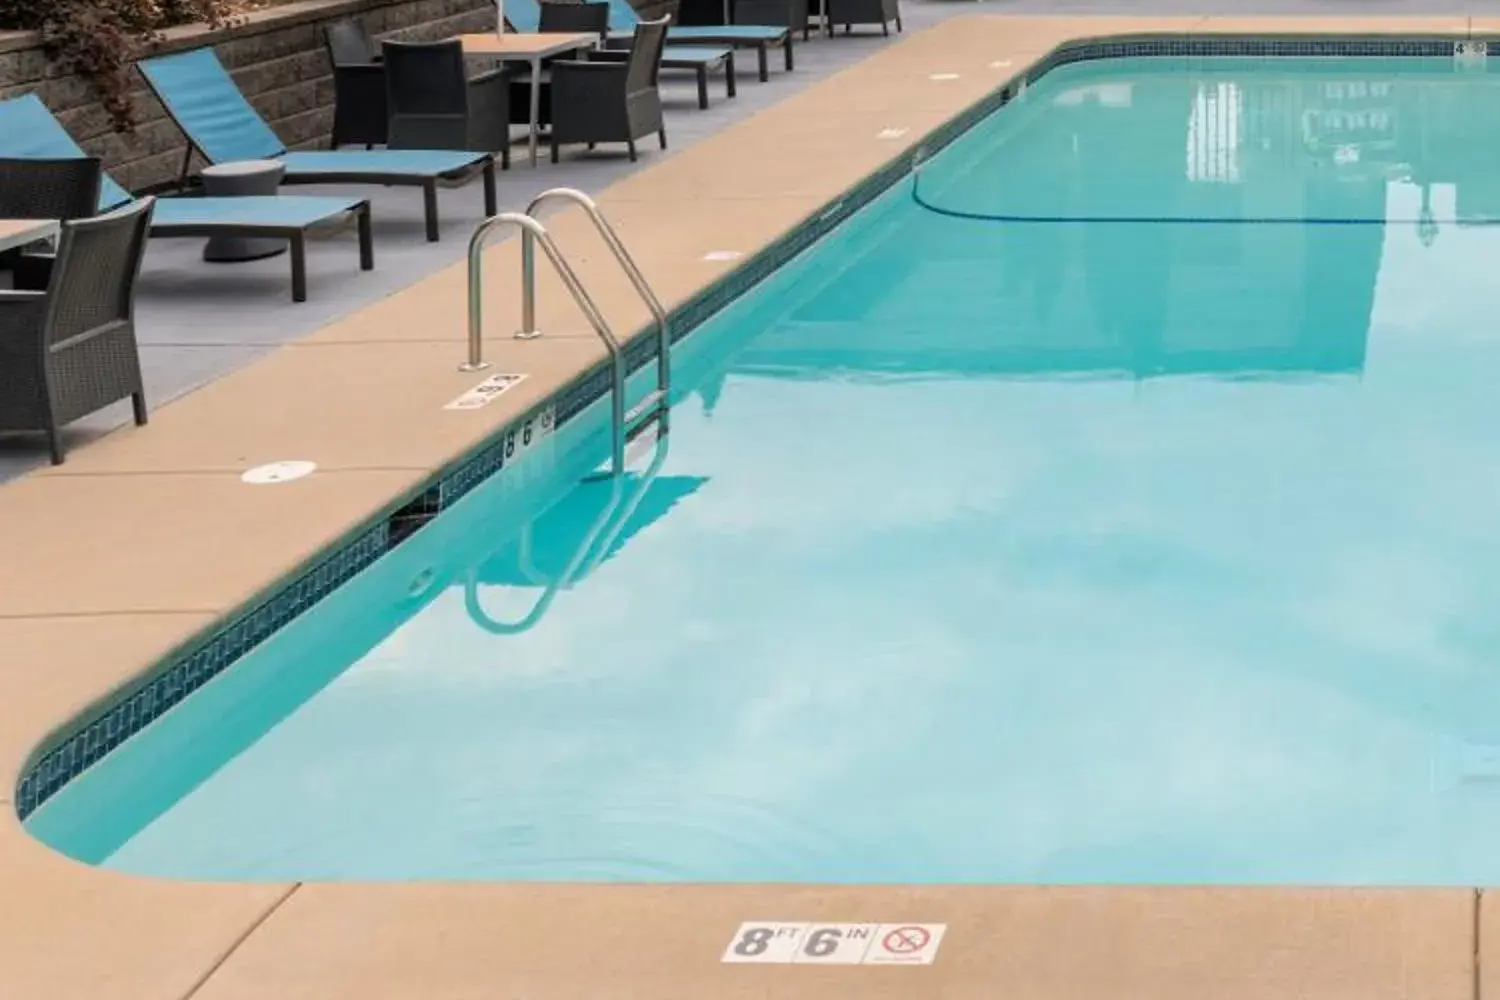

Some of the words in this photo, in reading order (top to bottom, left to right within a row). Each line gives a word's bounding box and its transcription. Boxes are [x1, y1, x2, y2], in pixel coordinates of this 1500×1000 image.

[523, 420, 532, 445] 6
[734, 928, 775, 956] 8
[776, 928, 800, 939] FT
[804, 928, 843, 957] 6
[846, 929, 870, 940] IN
